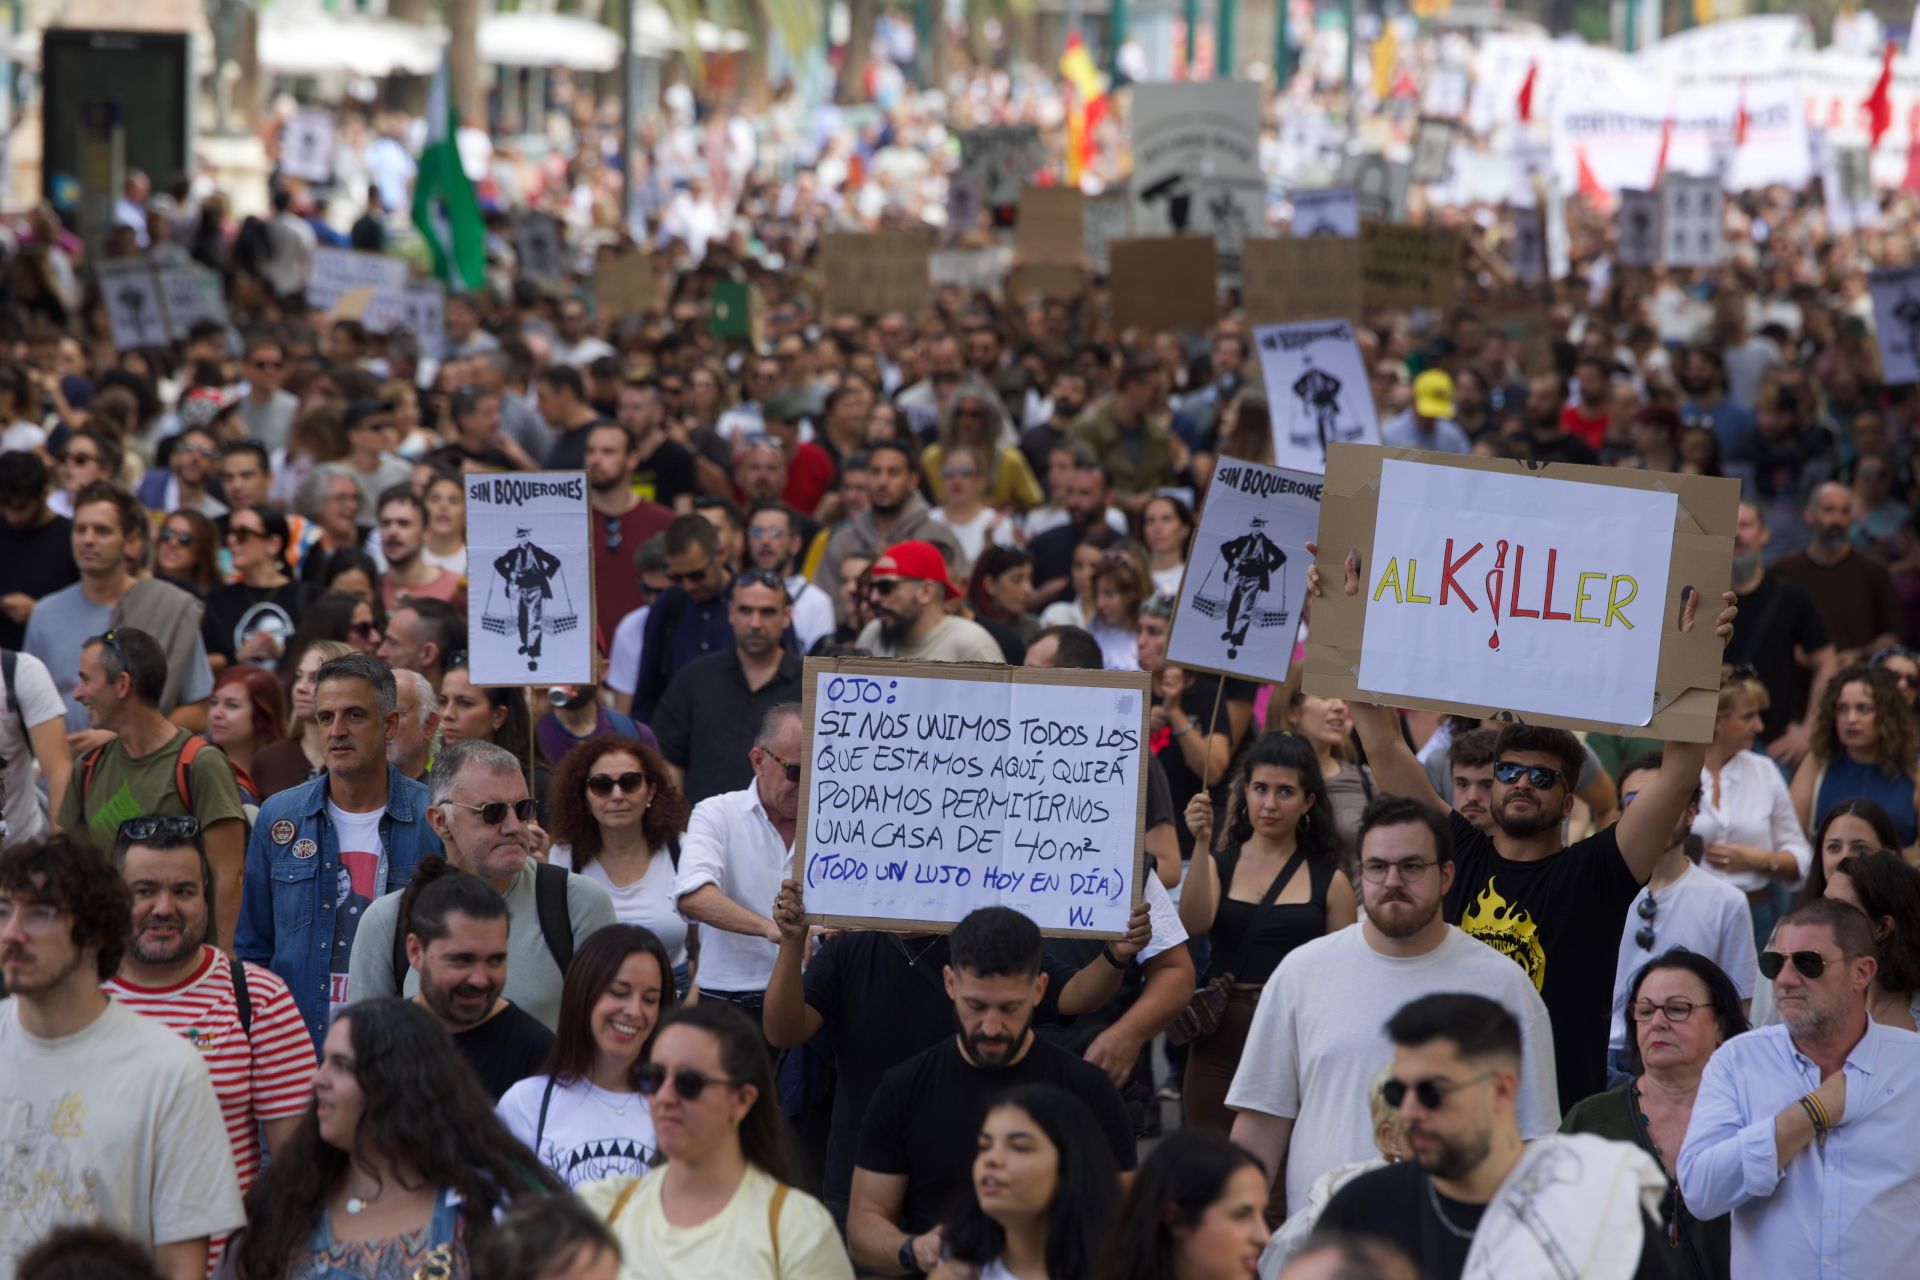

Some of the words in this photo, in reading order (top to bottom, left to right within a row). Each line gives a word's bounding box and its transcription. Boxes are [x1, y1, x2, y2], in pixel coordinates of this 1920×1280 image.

[470, 481, 491, 503] SIN
[494, 478, 583, 507] BOQUERONES
[1218, 467, 1241, 489] SIN
[1241, 468, 1324, 502] BOQUERONE
[827, 676, 898, 705] OJO:
[818, 711, 856, 739] SI
[858, 711, 911, 741] NOS
[916, 713, 1012, 743] UNIMOS
[1019, 717, 1089, 747] TODOS
[1095, 725, 1139, 752] LOS
[816, 745, 870, 773] QUE
[872, 746, 984, 778] ESTAMOS
[990, 749, 1046, 786] AQUÍ,
[1052, 755, 1129, 785] QUIZÁ
[817, 780, 933, 816] PODAMOS
[941, 787, 1110, 824] PERMITIRNOS
[815, 818, 866, 845] UNA
[871, 822, 943, 851] CASA
[957, 824, 1002, 854] DE
[806, 852, 868, 889] (TODO
[875, 859, 908, 882] UN
[914, 863, 972, 887] LUJO
[982, 865, 1026, 893] HOY
[1029, 872, 1061, 894] EN
[1069, 867, 1125, 902] DÍA)
